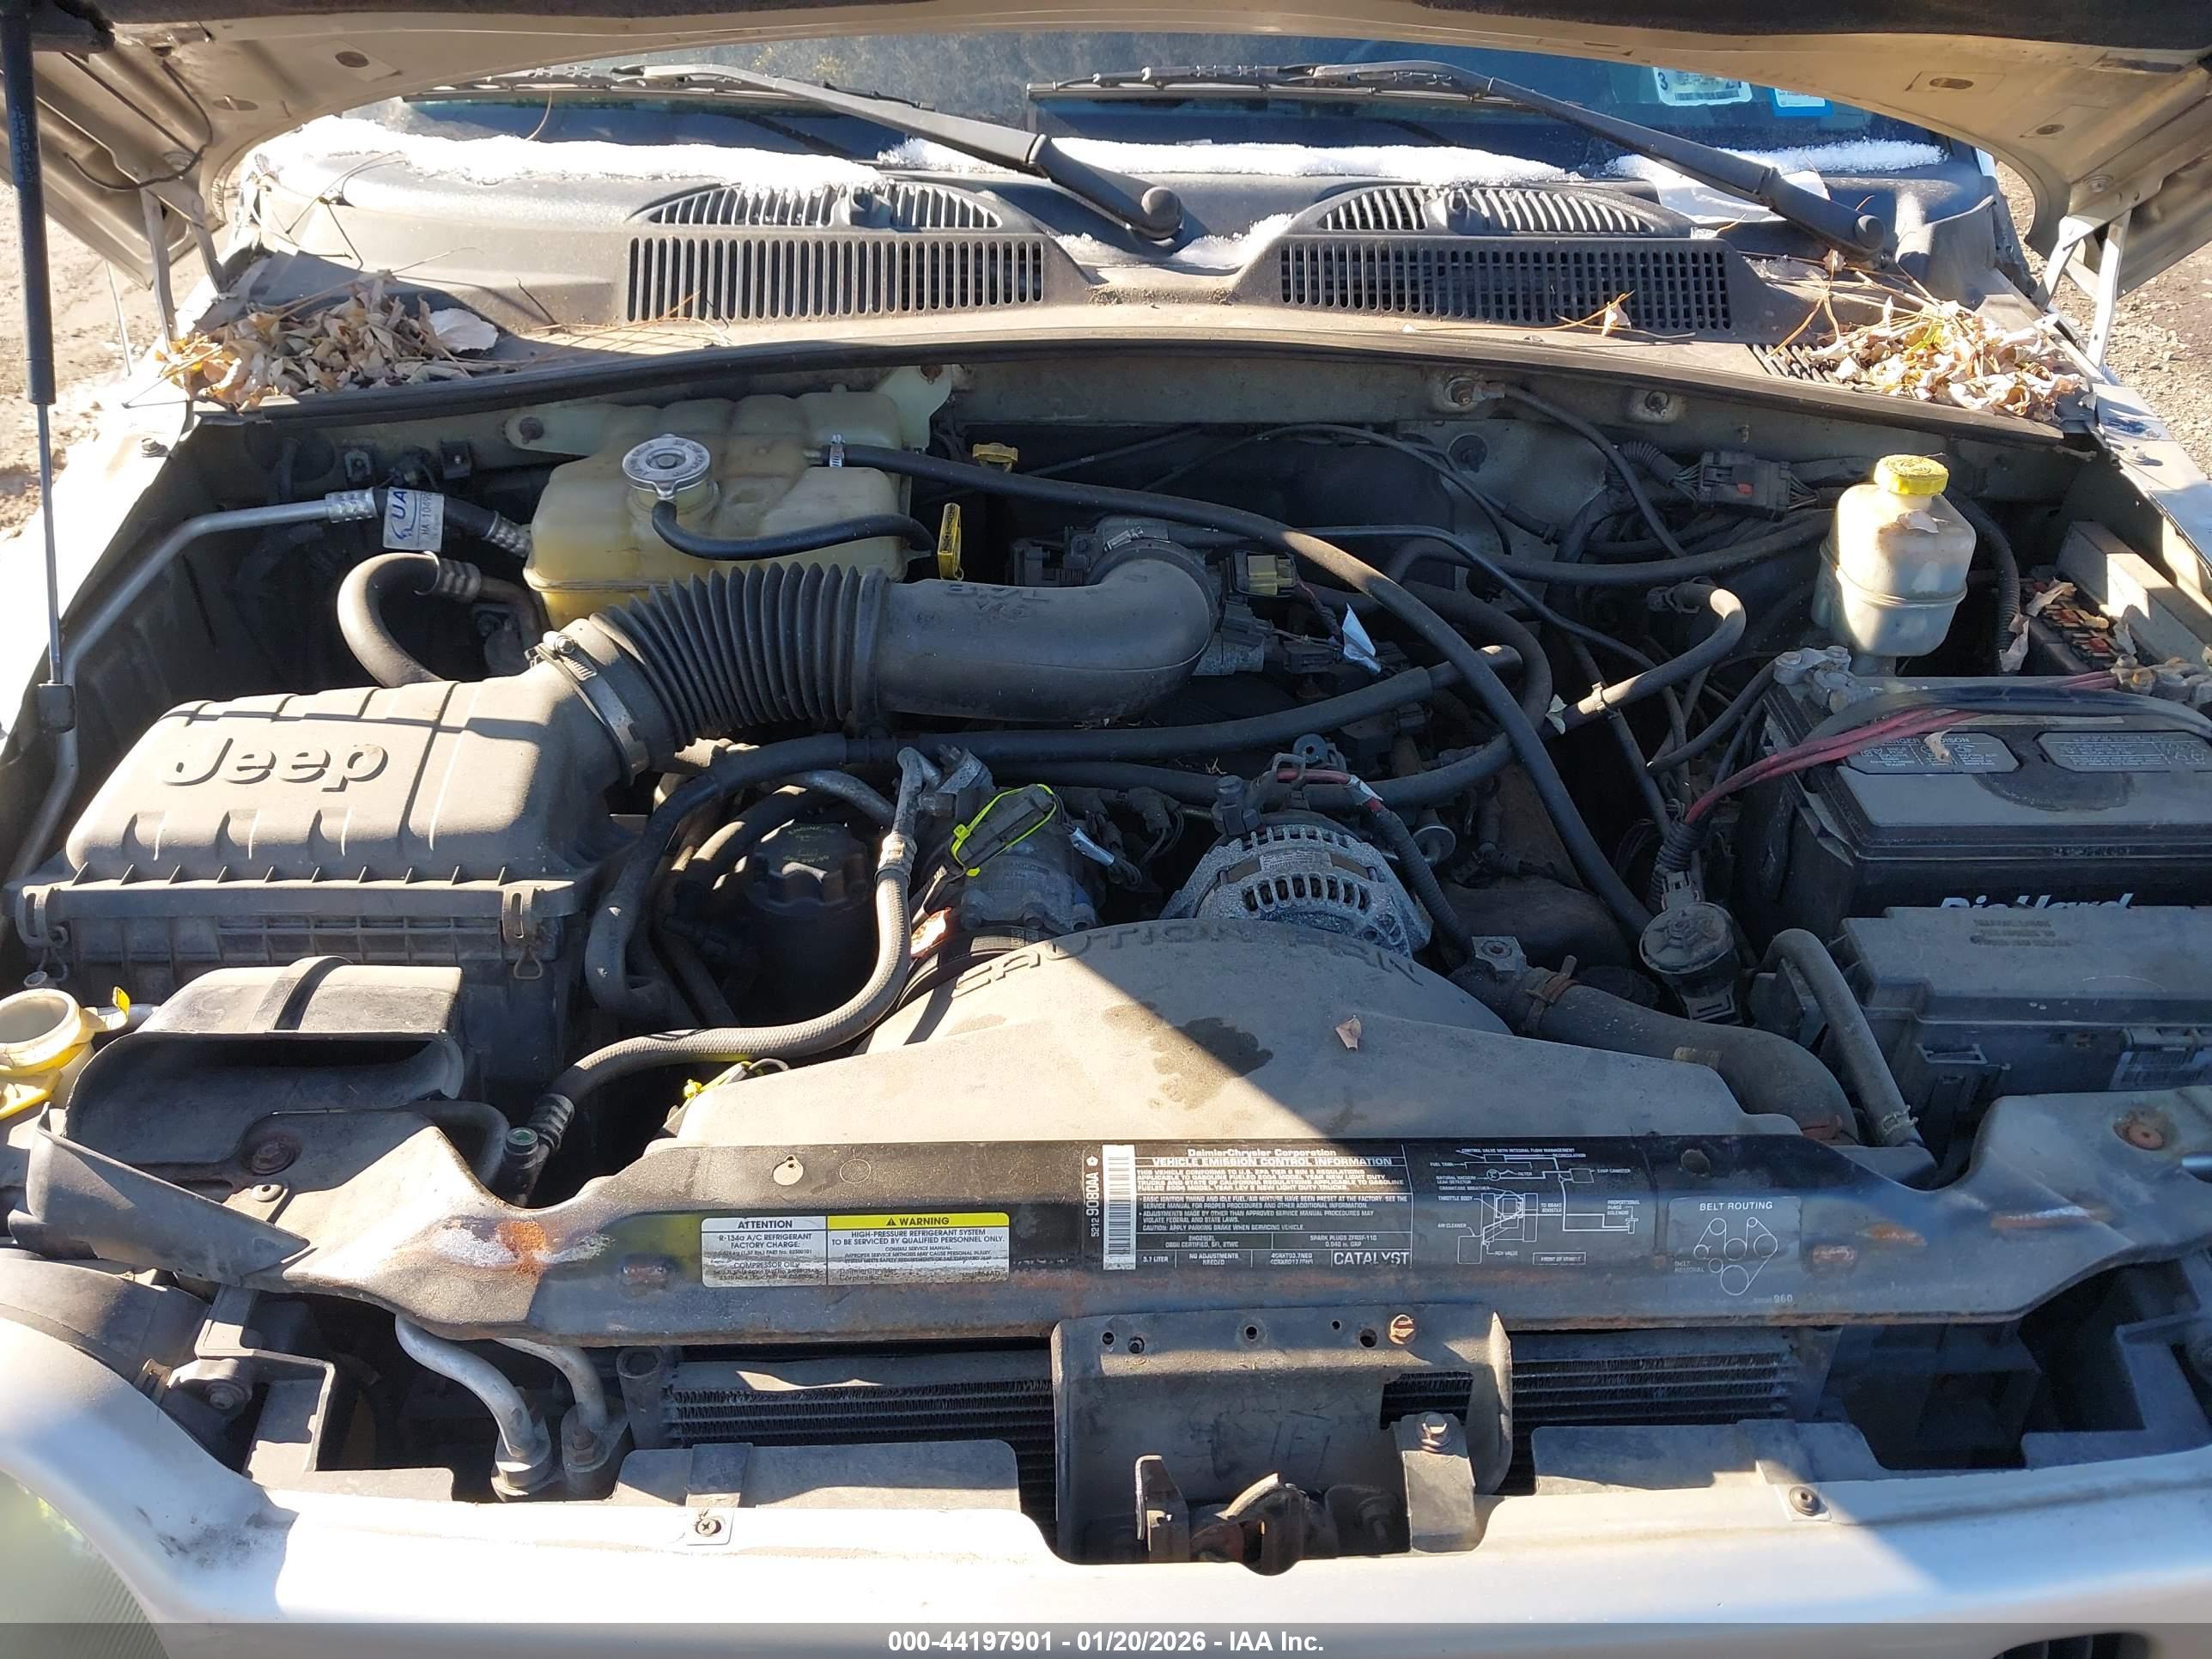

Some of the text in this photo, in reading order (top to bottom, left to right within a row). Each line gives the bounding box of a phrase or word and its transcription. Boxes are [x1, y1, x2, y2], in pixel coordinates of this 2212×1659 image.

[161, 736, 389, 793] Jeep
[952, 924, 1255, 1000] CAUTION
[1188, 1149, 1337, 1157] DaimlerChrysler Corporation
[1700, 1201, 1773, 1211] BELT ROUTING
[738, 1220, 792, 1229] ATTENTION
[900, 1217, 949, 1226] WARNING
[1334, 1252, 1410, 1265] CATALYST
